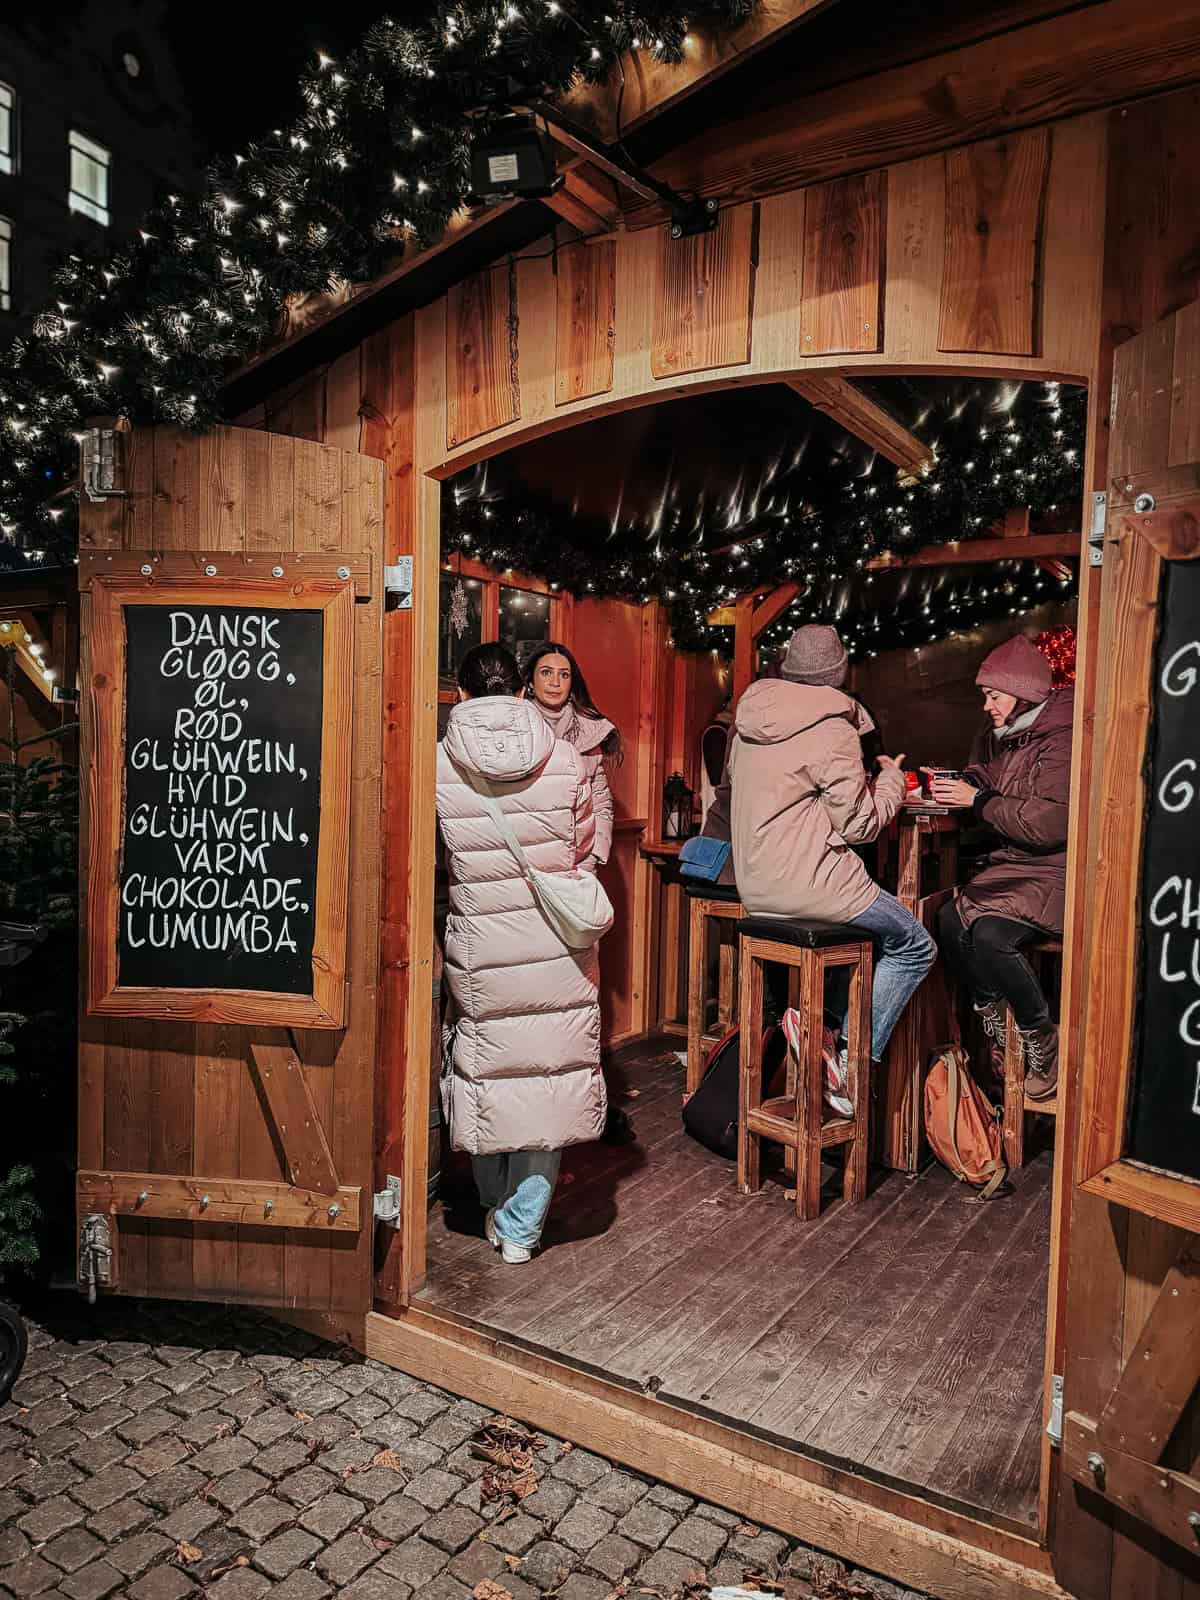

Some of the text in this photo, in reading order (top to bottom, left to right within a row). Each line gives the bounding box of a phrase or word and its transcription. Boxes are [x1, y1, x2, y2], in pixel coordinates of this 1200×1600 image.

[169, 612, 280, 648] DANSK
[160, 647, 296, 685] GLØGG,
[194, 679, 249, 710] ØL,
[175, 708, 242, 741] RØD
[131, 738, 307, 781] GLÜHWEIN,
[168, 772, 246, 806] HVID
[130, 804, 308, 847] GLÜHWEIN,
[174, 840, 270, 875] VARM
[122, 873, 309, 913] CHOKOLADE,
[128, 911, 296, 953] LUMUMBA
